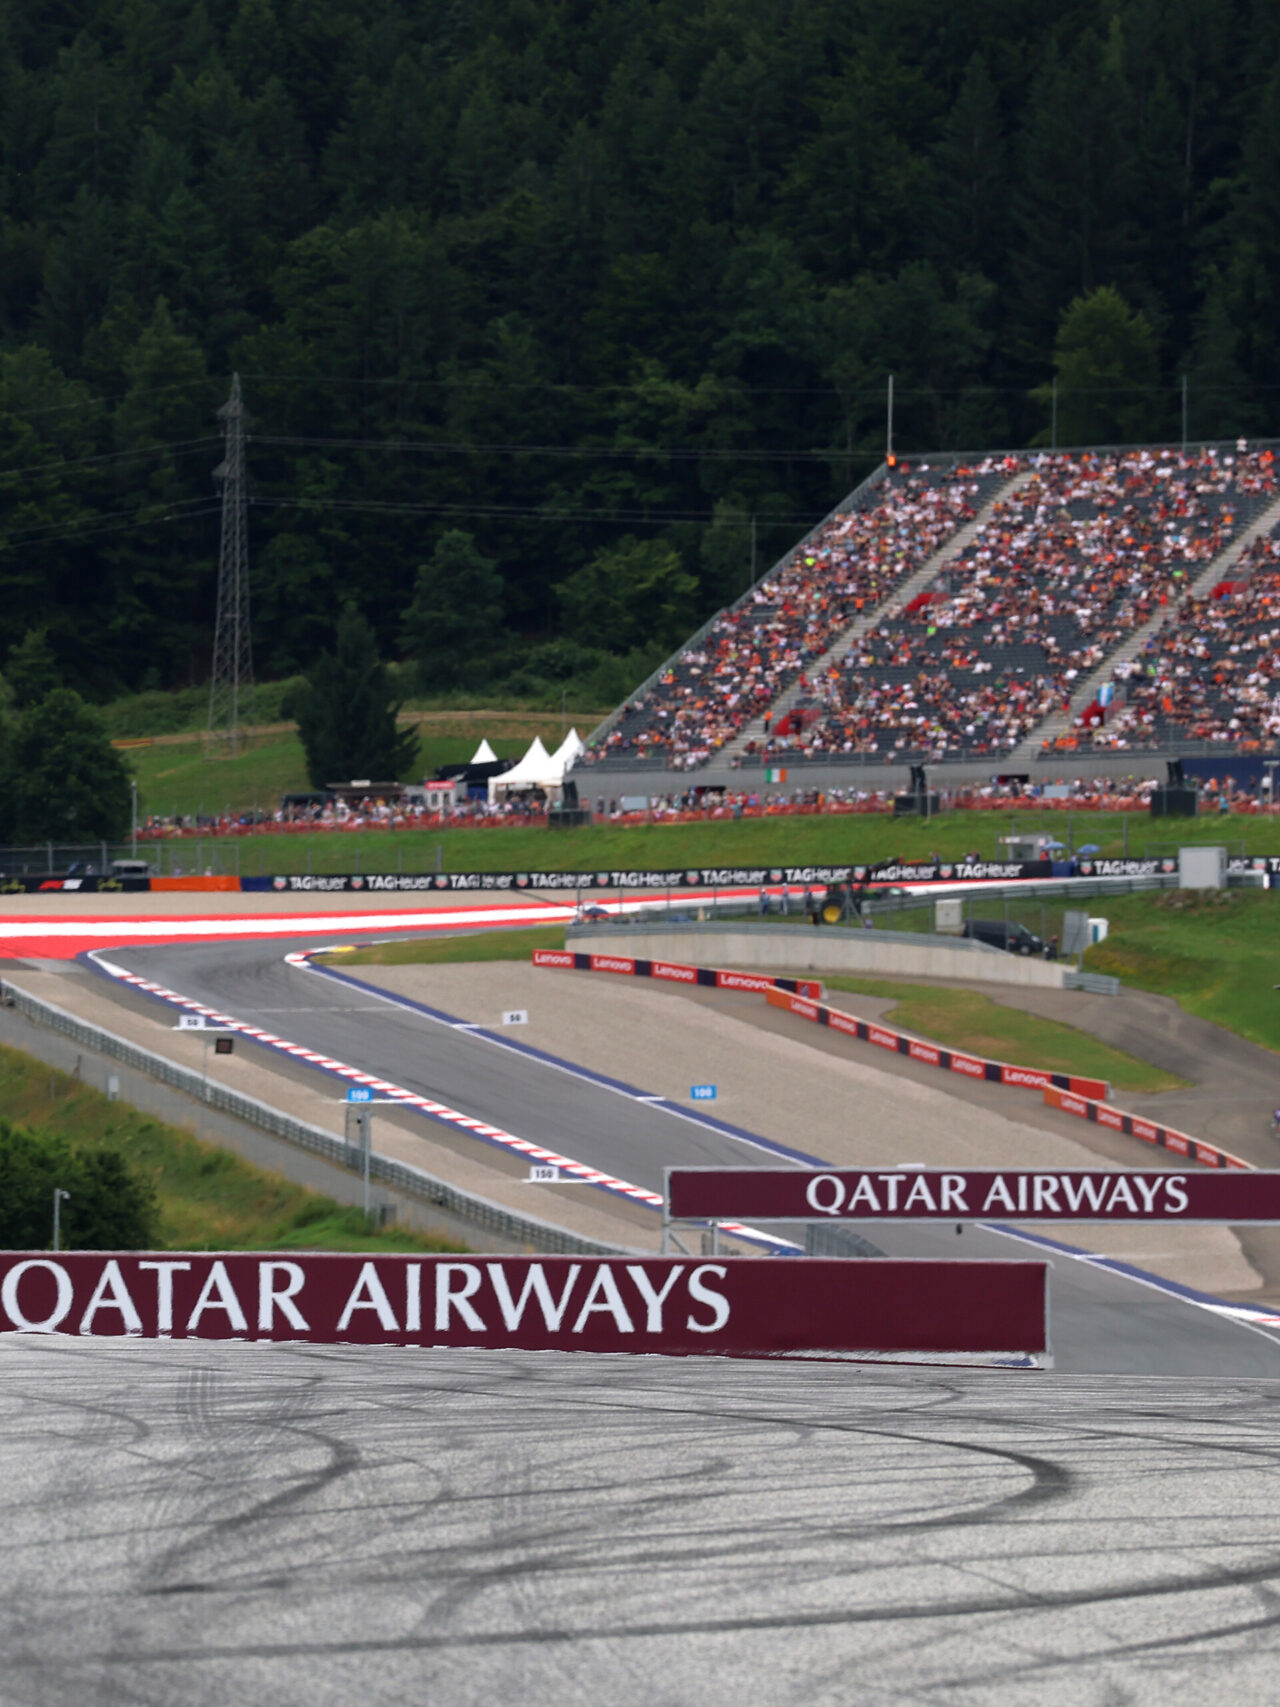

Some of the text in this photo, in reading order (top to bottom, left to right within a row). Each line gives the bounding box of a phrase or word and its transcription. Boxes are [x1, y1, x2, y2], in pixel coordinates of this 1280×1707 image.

[535, 952, 572, 966] Lenovo
[594, 957, 631, 972] Lenovo
[654, 964, 694, 980] Lenovo
[721, 973, 769, 990] Lenovo
[1004, 1069, 1048, 1087] Lenovo
[535, 1168, 554, 1179] 150
[806, 1174, 1189, 1214] QATAR AIRWAYS
[1, 1259, 731, 1335] QATAR AIRWAYS
